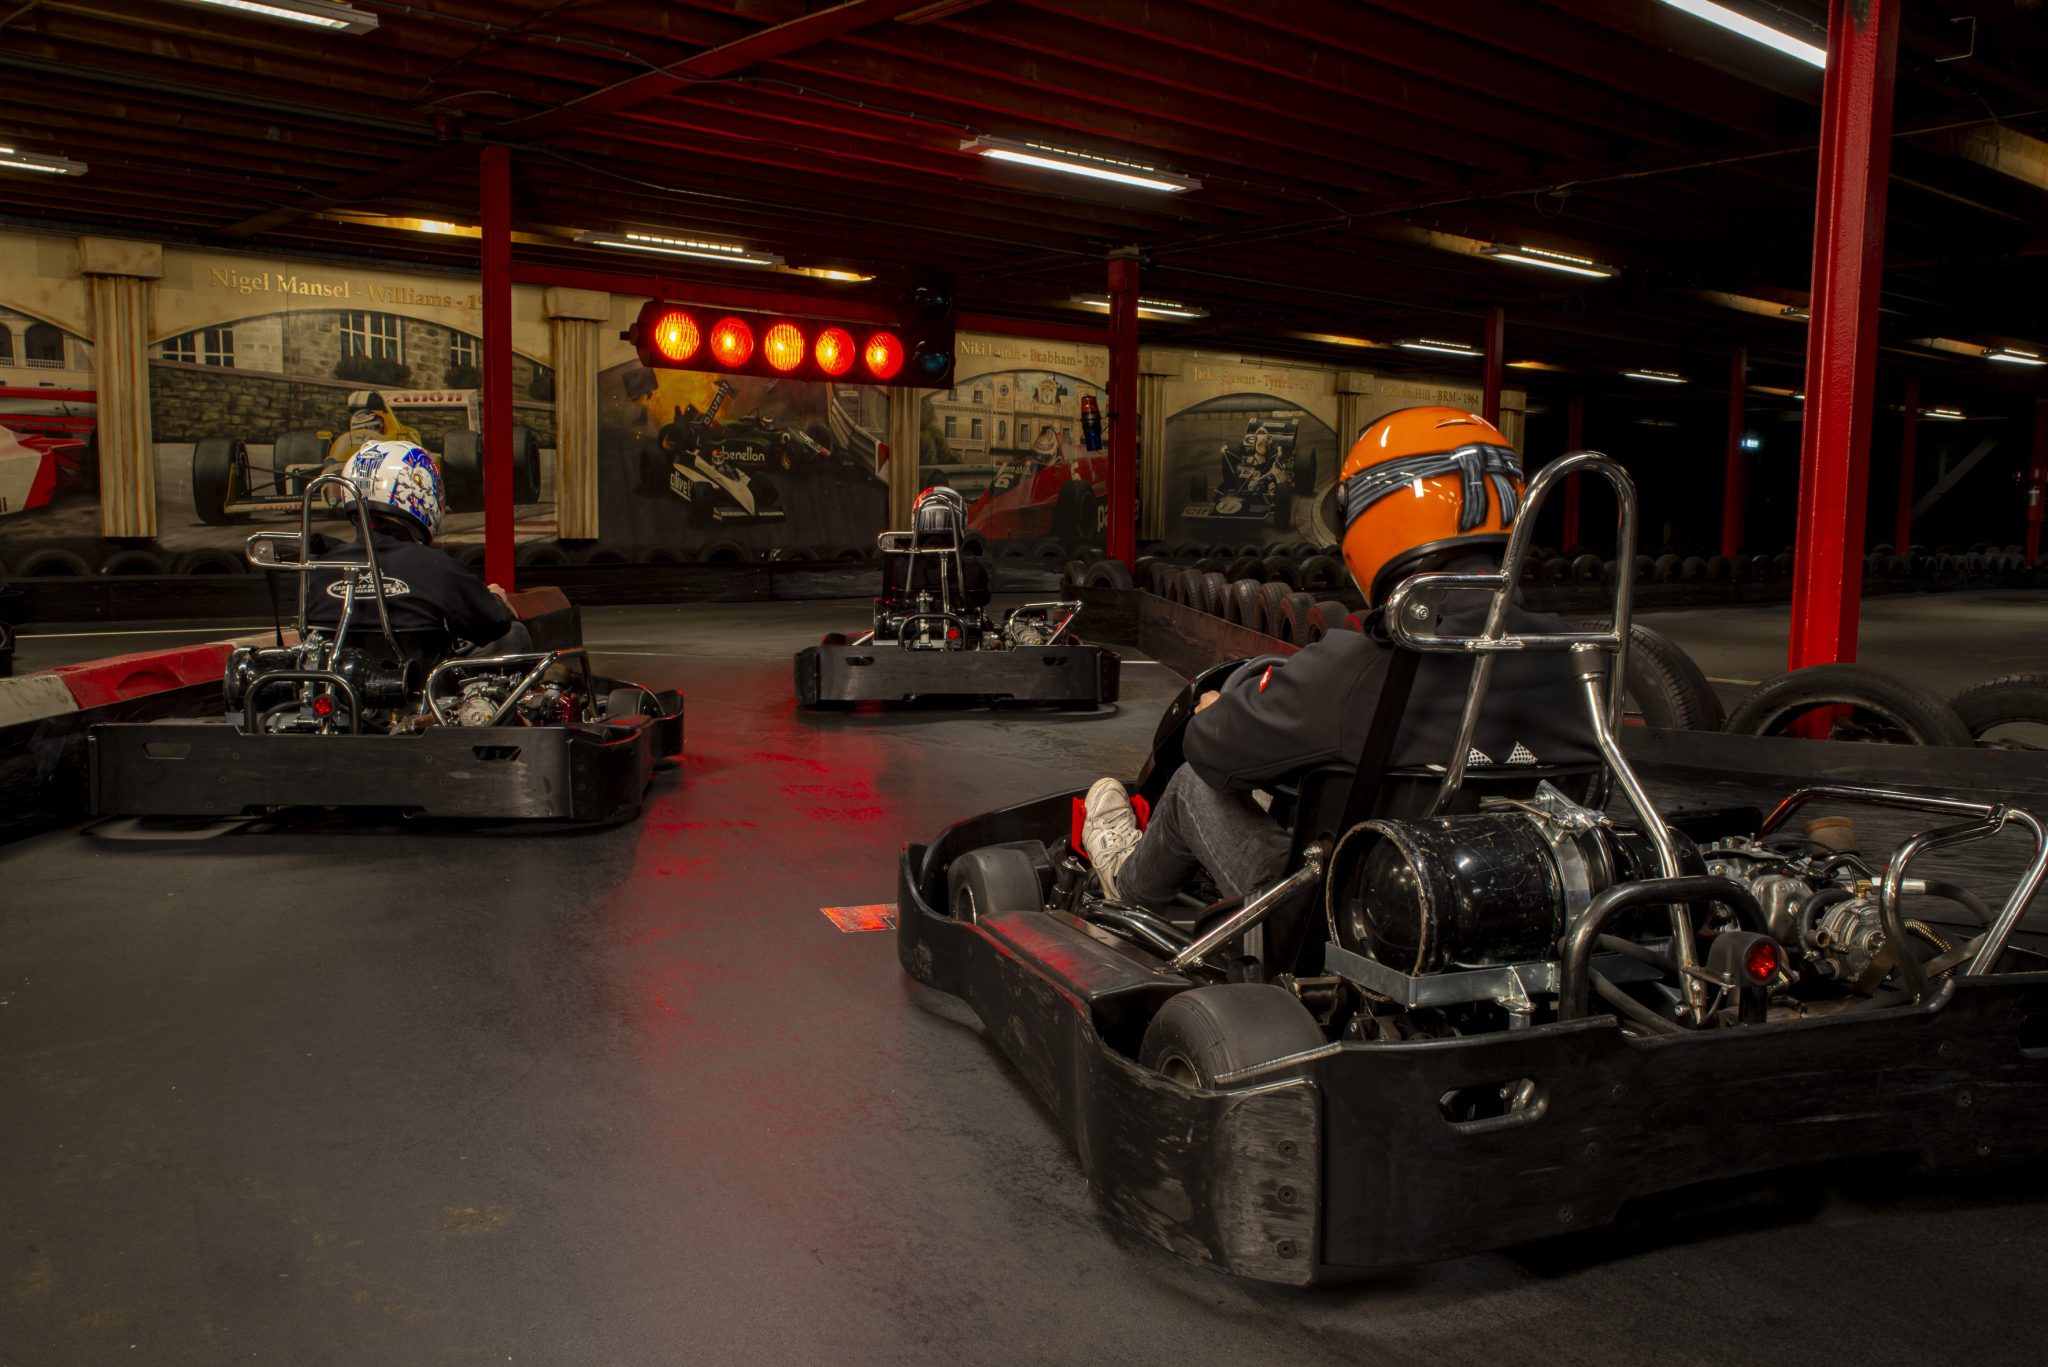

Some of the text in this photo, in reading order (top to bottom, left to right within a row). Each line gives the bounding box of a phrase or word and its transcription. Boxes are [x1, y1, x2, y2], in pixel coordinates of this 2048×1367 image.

[209, 267, 269, 294] Nigel
[276, 274, 350, 299] Mansel
[367, 282, 452, 308] Williams
[961, 341, 1105, 369] Niki Lauda Brabham 1979
[1223, 370, 1257, 386] Stewart
[1415, 388, 1431, 401] Hill
[1438, 389, 1457, 403] BRM
[1463, 392, 1479, 406] 1964
